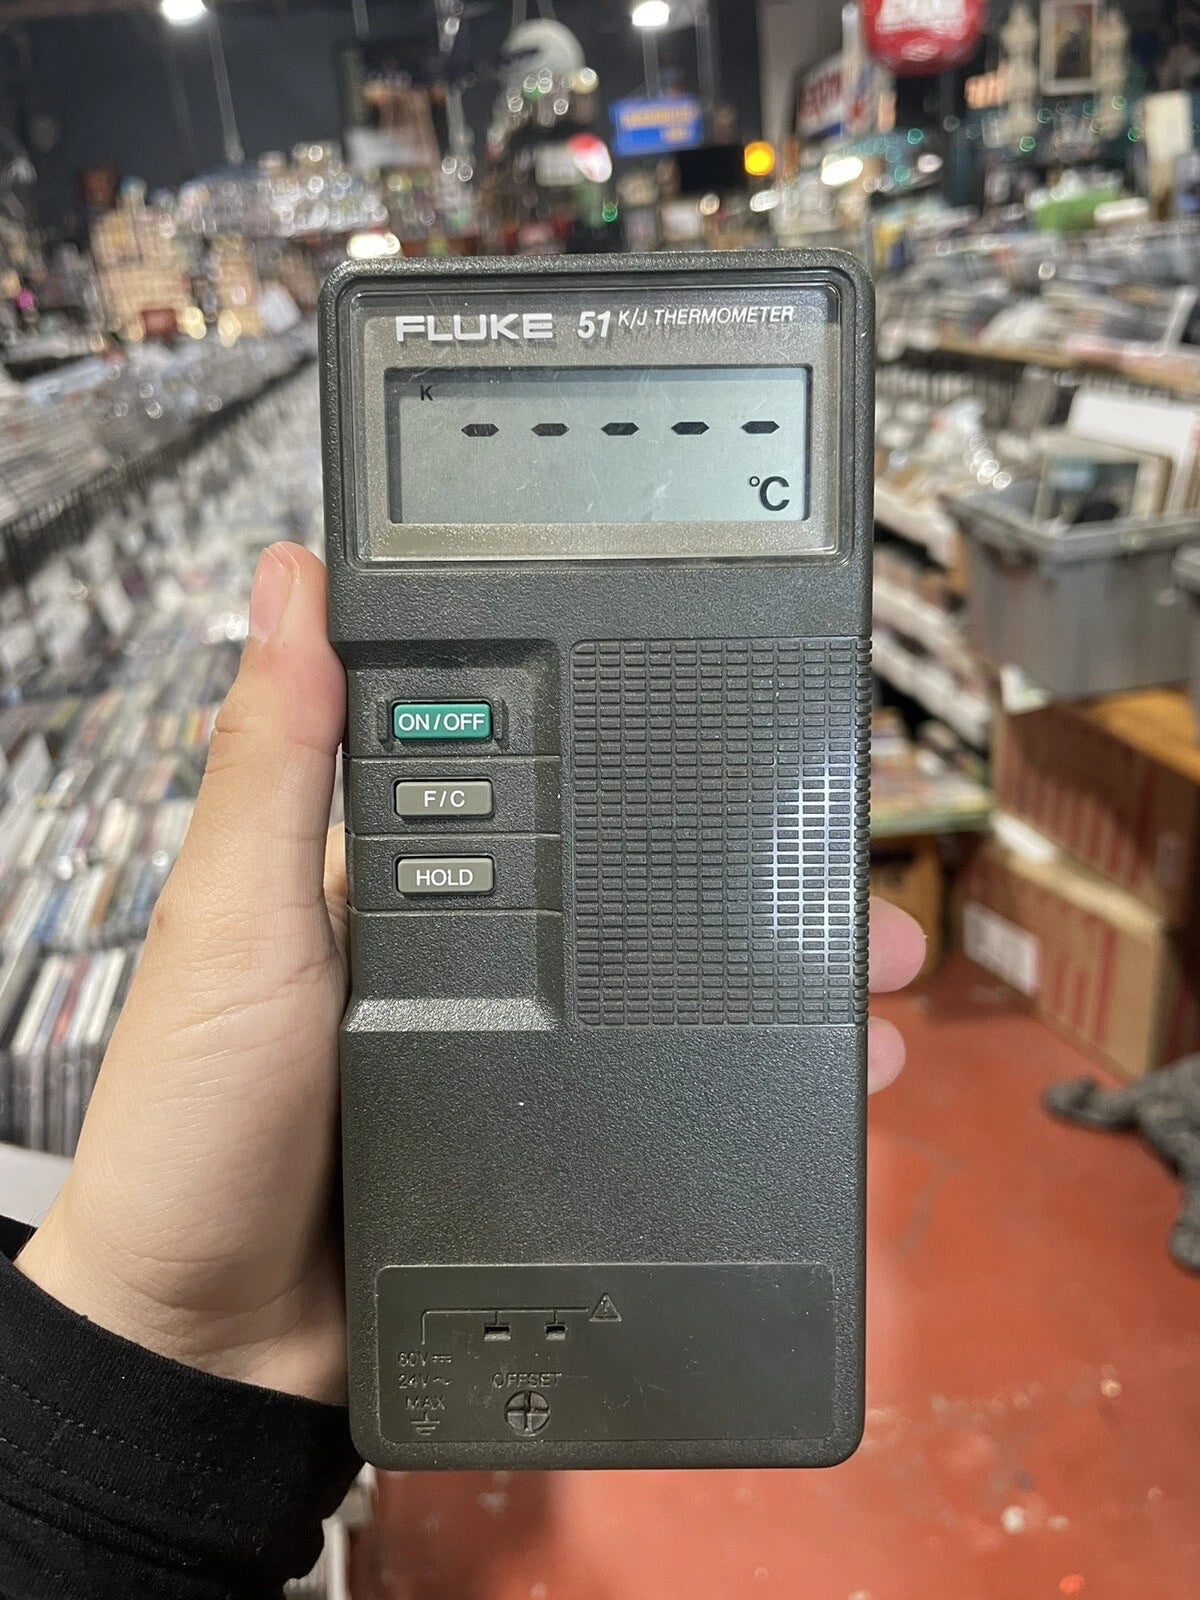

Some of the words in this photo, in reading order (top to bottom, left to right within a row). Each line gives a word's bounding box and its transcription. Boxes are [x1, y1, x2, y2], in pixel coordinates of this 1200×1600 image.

[618, 309, 648, 329] K/J
[653, 305, 795, 327] THERMOMETER
[396, 313, 553, 342] FLUKE
[577, 311, 611, 339] 51
[420, 385, 434, 402] K
[416, 869, 474, 887] HOLD
[492, 1373, 562, 1389] OFFSET
[405, 1396, 446, 1411] MAX
